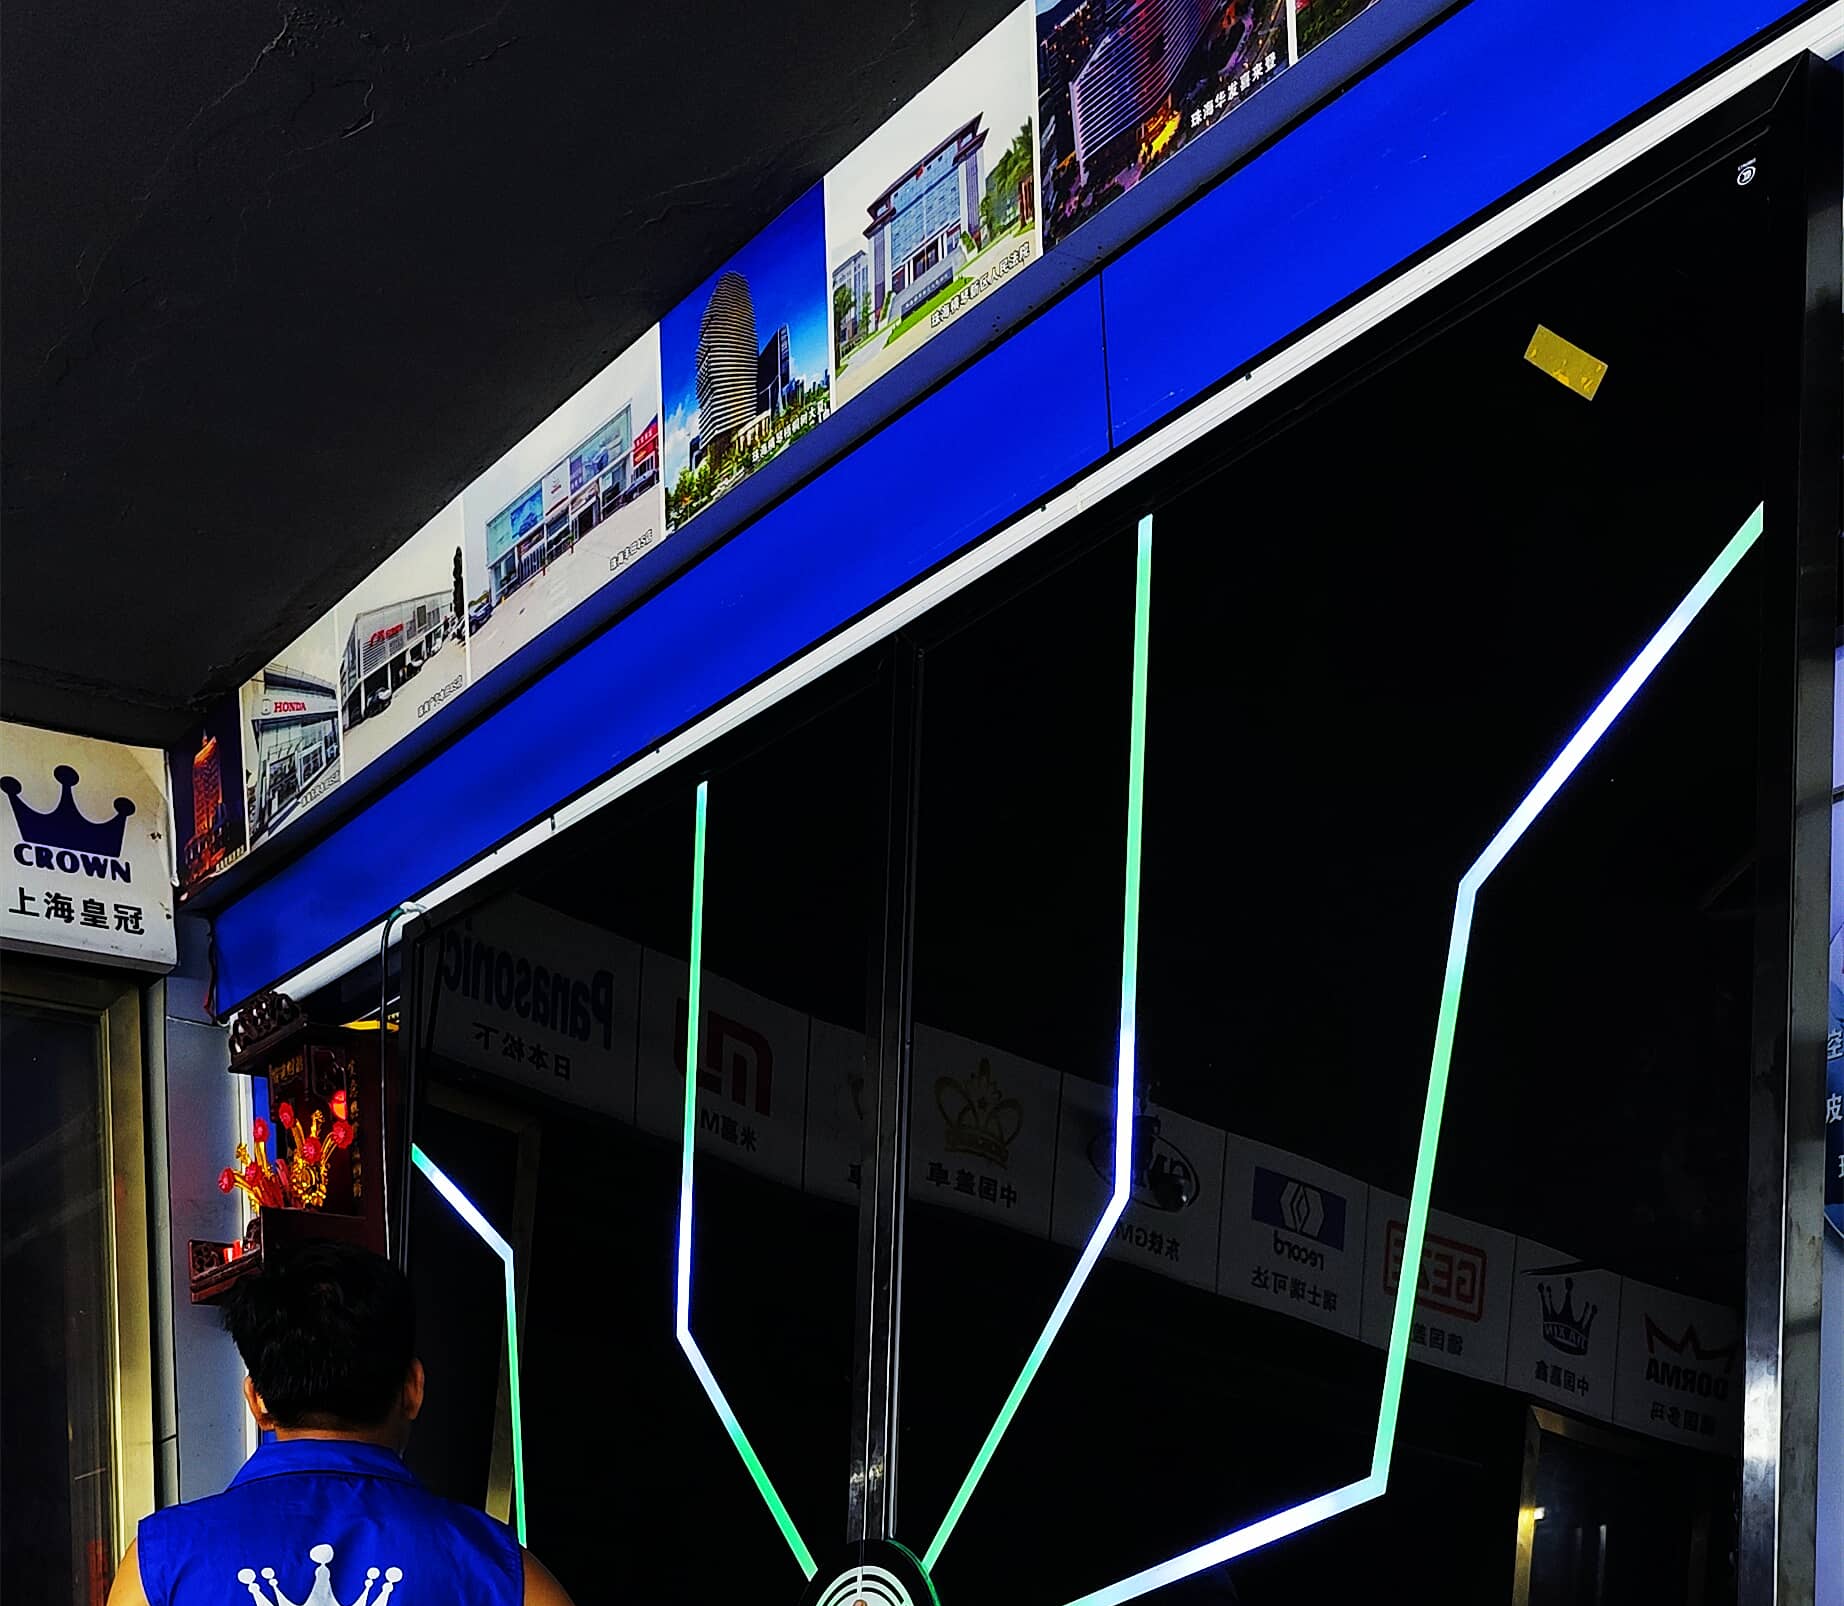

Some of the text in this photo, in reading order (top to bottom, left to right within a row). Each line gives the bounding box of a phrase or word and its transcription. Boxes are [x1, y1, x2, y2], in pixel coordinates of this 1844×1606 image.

[274, 702, 306, 713] HONDA
[14, 843, 131, 883] CROWN
[9, 887, 144, 935] 上海皇冠
